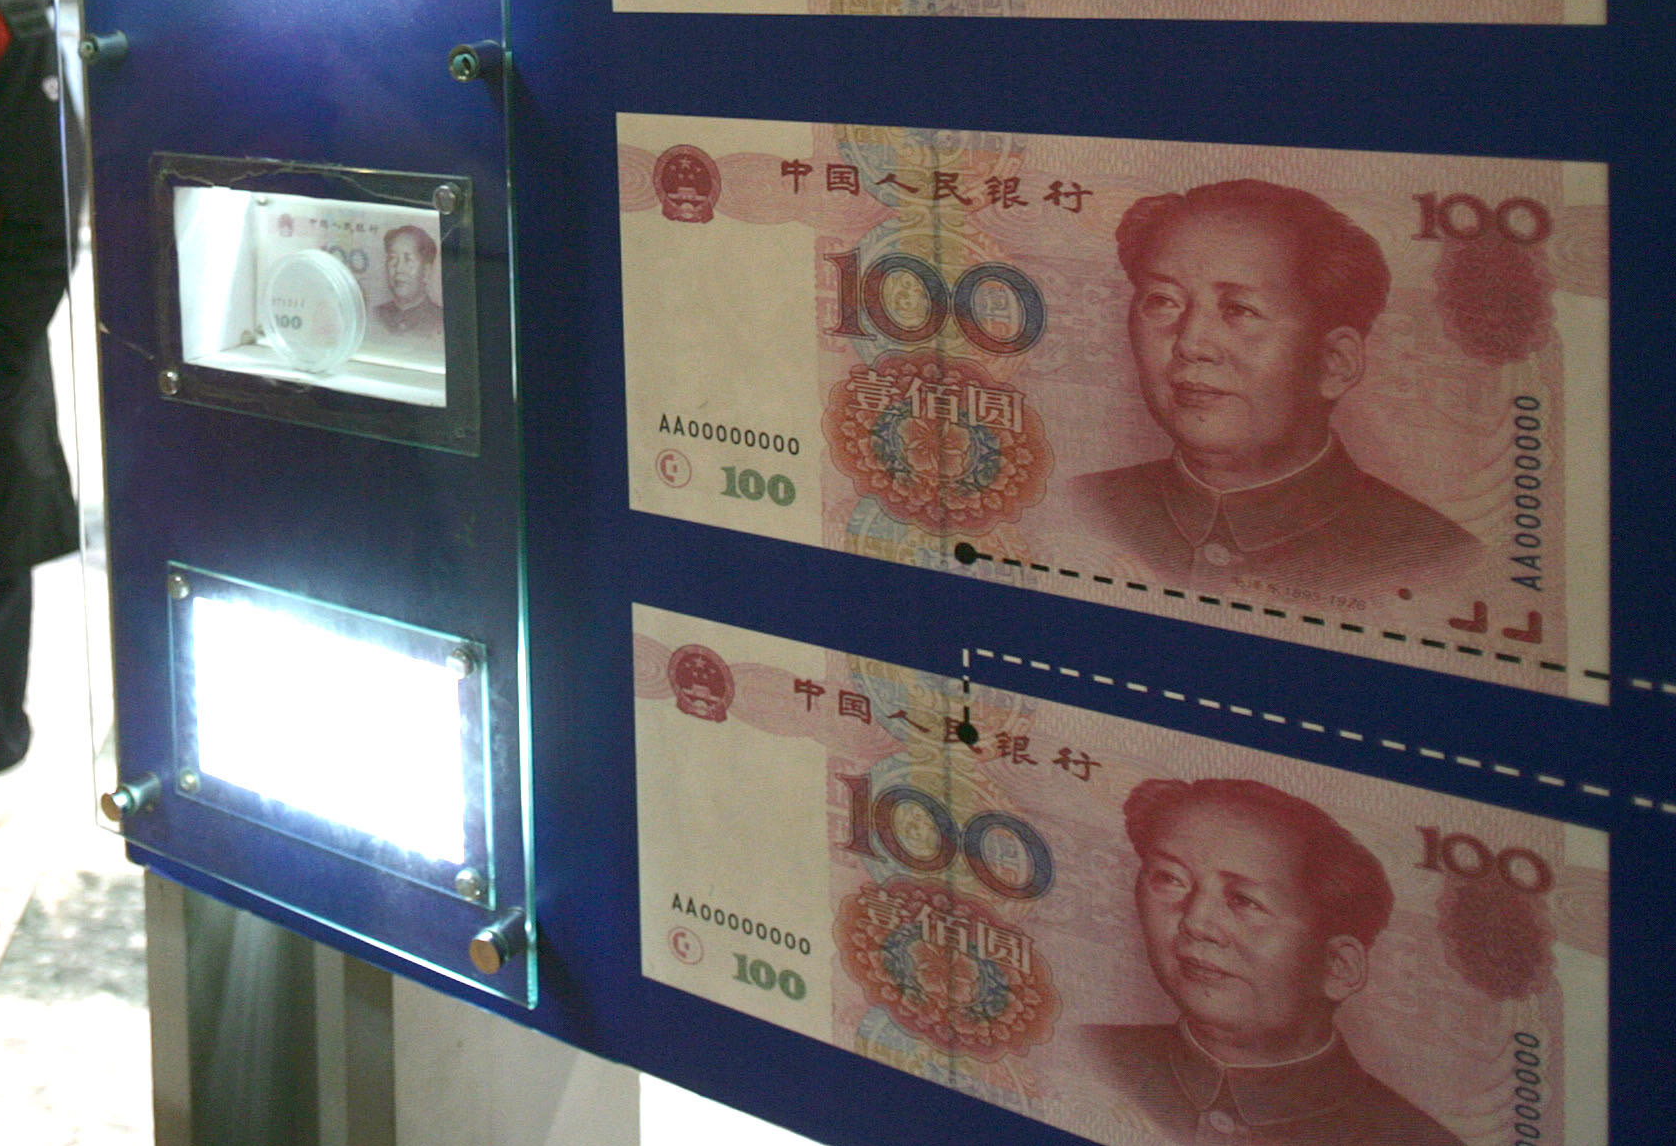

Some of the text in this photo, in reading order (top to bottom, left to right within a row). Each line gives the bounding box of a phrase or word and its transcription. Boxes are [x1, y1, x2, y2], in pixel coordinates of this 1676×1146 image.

[780, 159, 1094, 213] 中国人民银行
[1411, 191, 1553, 245] 100
[824, 246, 1046, 355] 100
[846, 367, 1023, 433] 壹佰圆
[659, 414, 800, 456] AA00000000
[720, 465, 796, 507] 100
[1511, 395, 1543, 592] AA00000000
[833, 772, 1056, 901] 100
[1415, 825, 1554, 894] 100
[672, 892, 811, 955] AA00000000
[859, 881, 1033, 975] 壹佰圆
[731, 952, 807, 1000] 100
